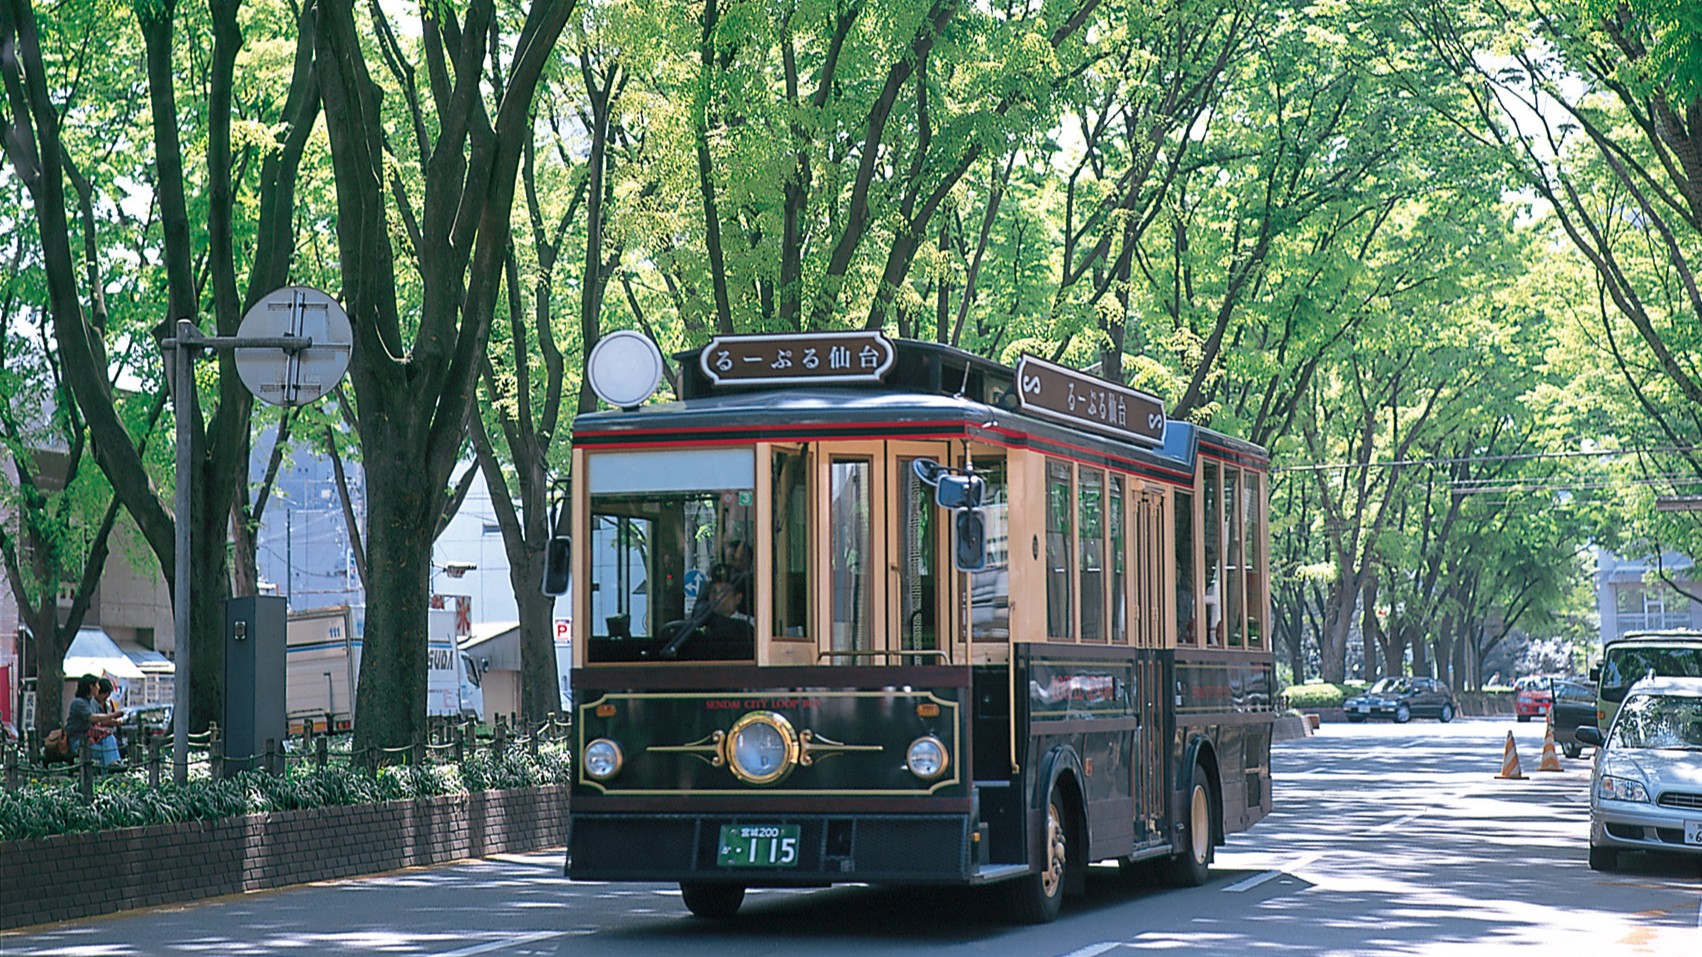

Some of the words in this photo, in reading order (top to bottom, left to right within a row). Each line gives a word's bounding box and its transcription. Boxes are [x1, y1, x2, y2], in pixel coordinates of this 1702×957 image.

[715, 344, 880, 371] るーぷる仙台
[1067, 382, 1127, 427] るーぷる仙台
[557, 624, 567, 637] P
[706, 700, 740, 709] SENDAI
[744, 700, 767, 709] CITY
[771, 699, 798, 709] LOOP
